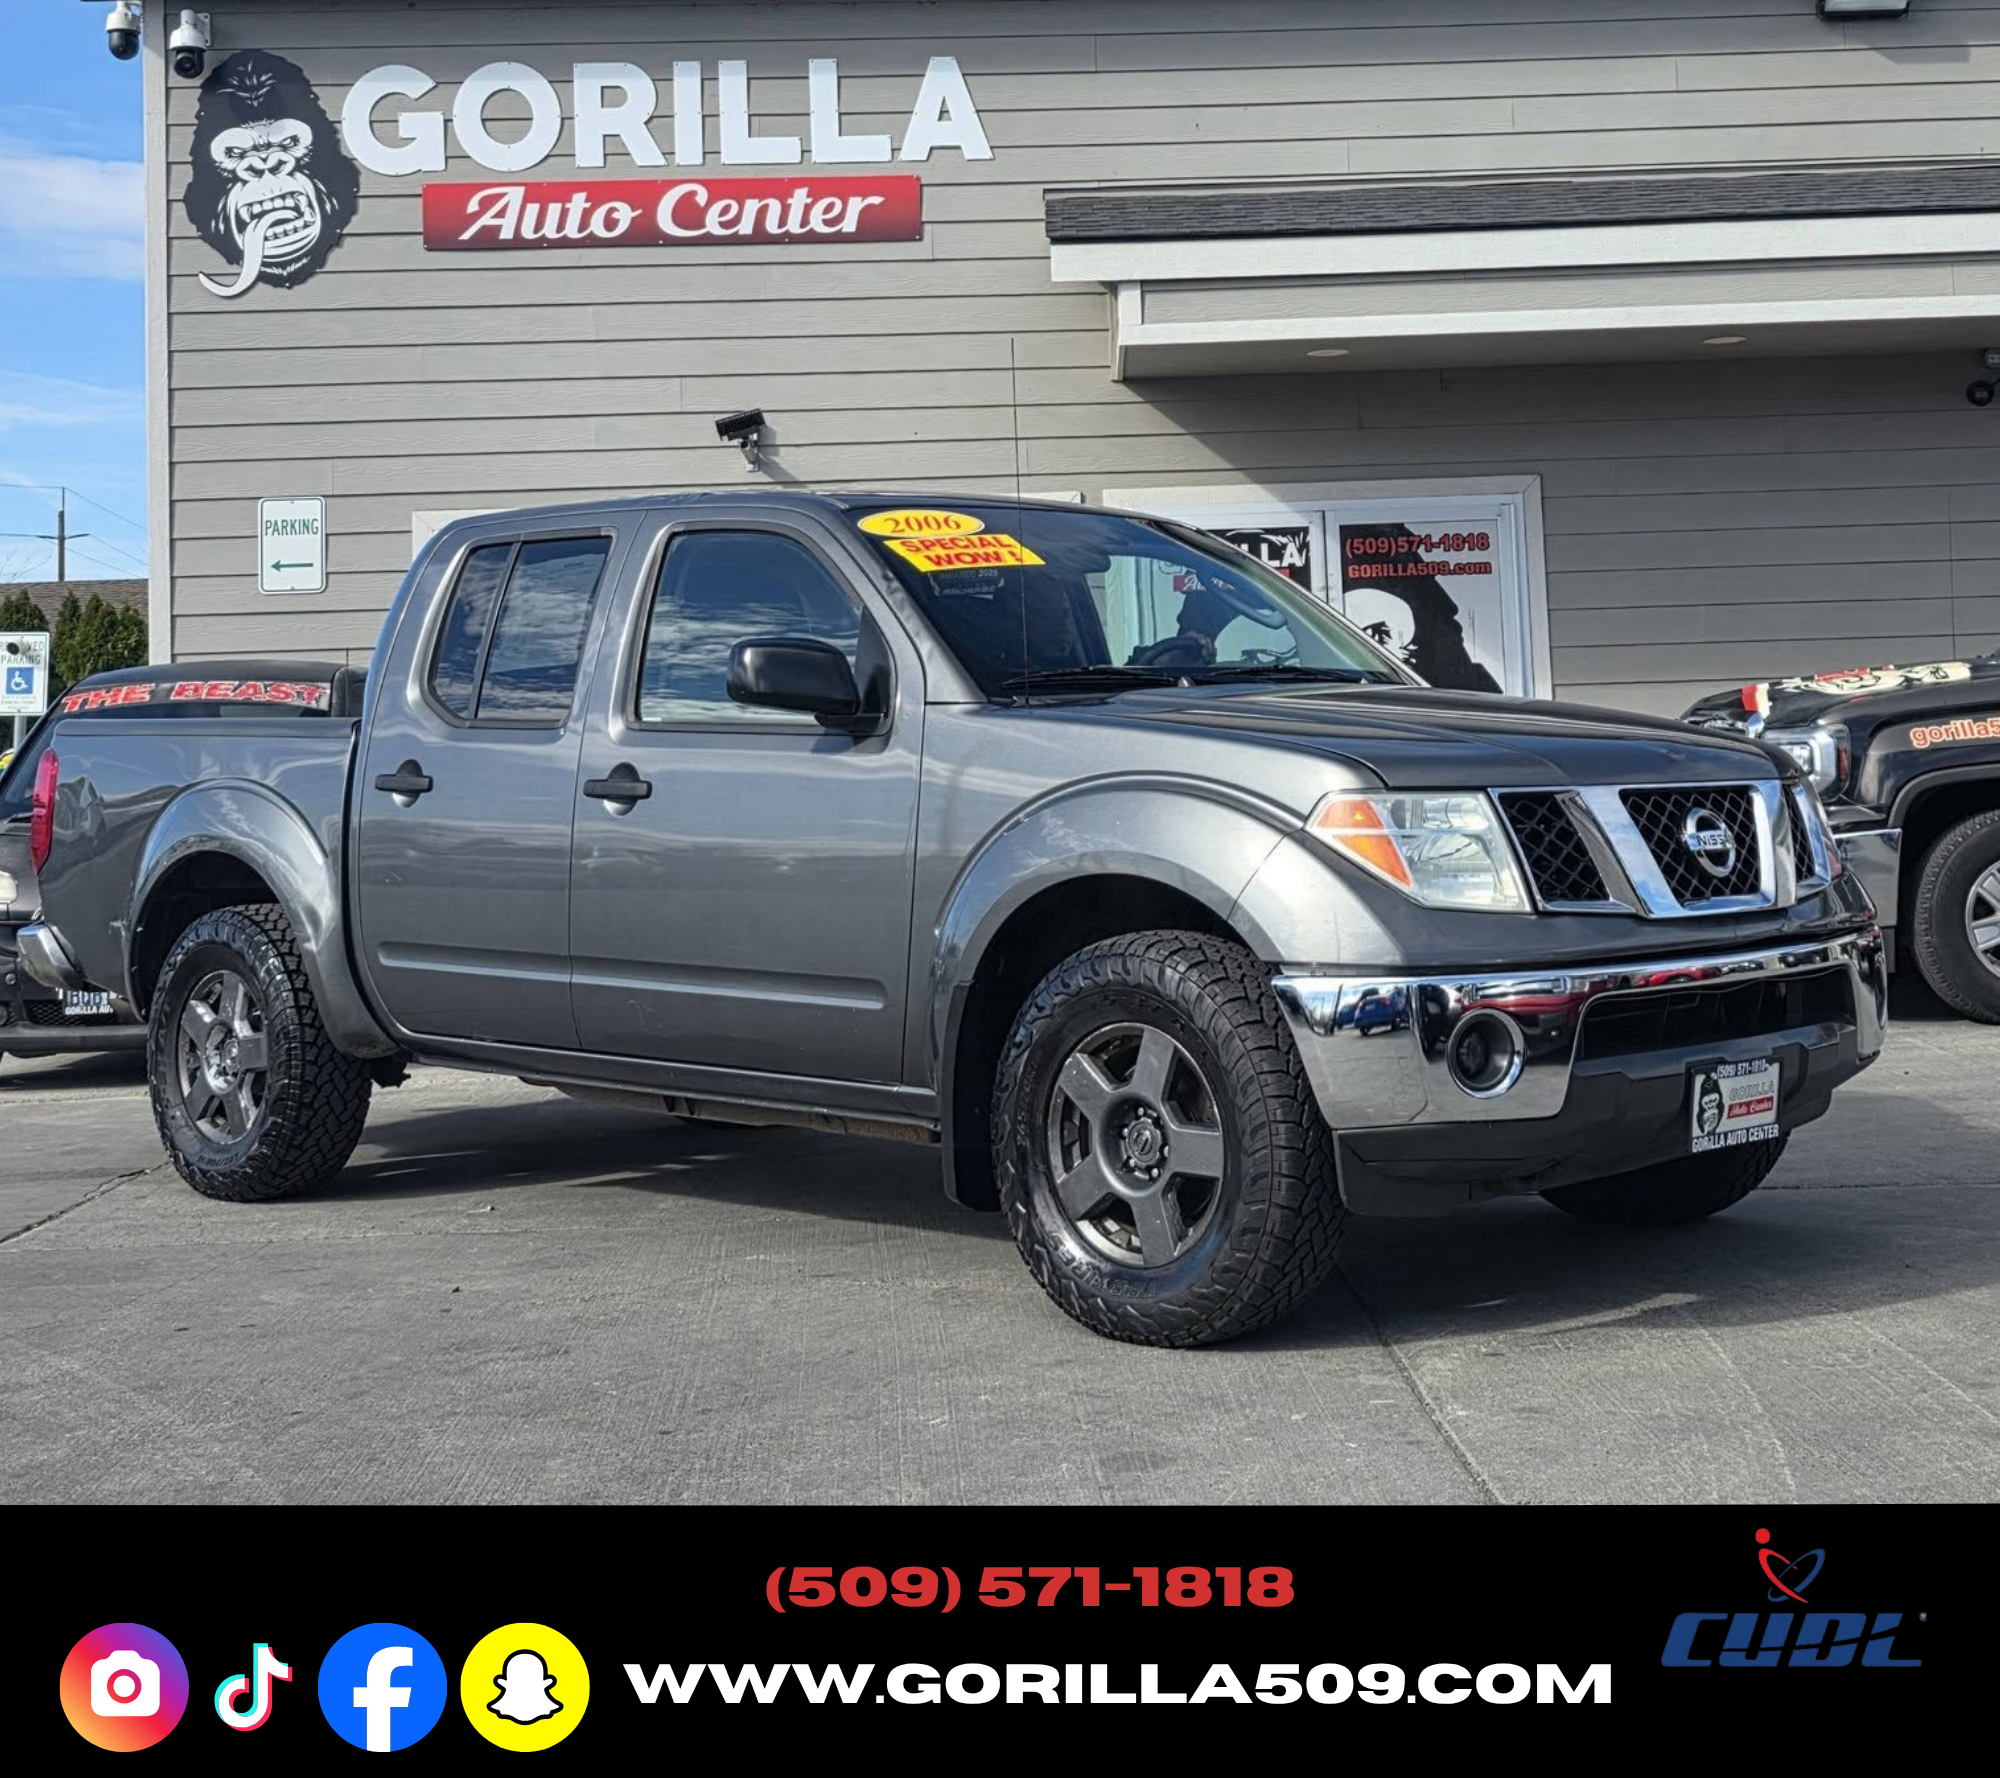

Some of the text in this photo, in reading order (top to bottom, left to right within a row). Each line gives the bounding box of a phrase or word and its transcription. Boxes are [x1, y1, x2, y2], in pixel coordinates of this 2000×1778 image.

[342, 56, 993, 176] GORILLA
[458, 182, 886, 241] Auto Center
[264, 518, 319, 536] PARKING
[884, 514, 962, 533] 2006
[899, 535, 1014, 552] SPECIAL
[1345, 532, 1490, 559] (509)571-1818
[1347, 561, 1492, 579] GORILLA509.com
[1, 655, 41, 666] PARKING
[62, 683, 155, 713] THE
[170, 681, 329, 706] BEAST
[1692, 1124, 1779, 1153] GORILLA AUTO CENTER
